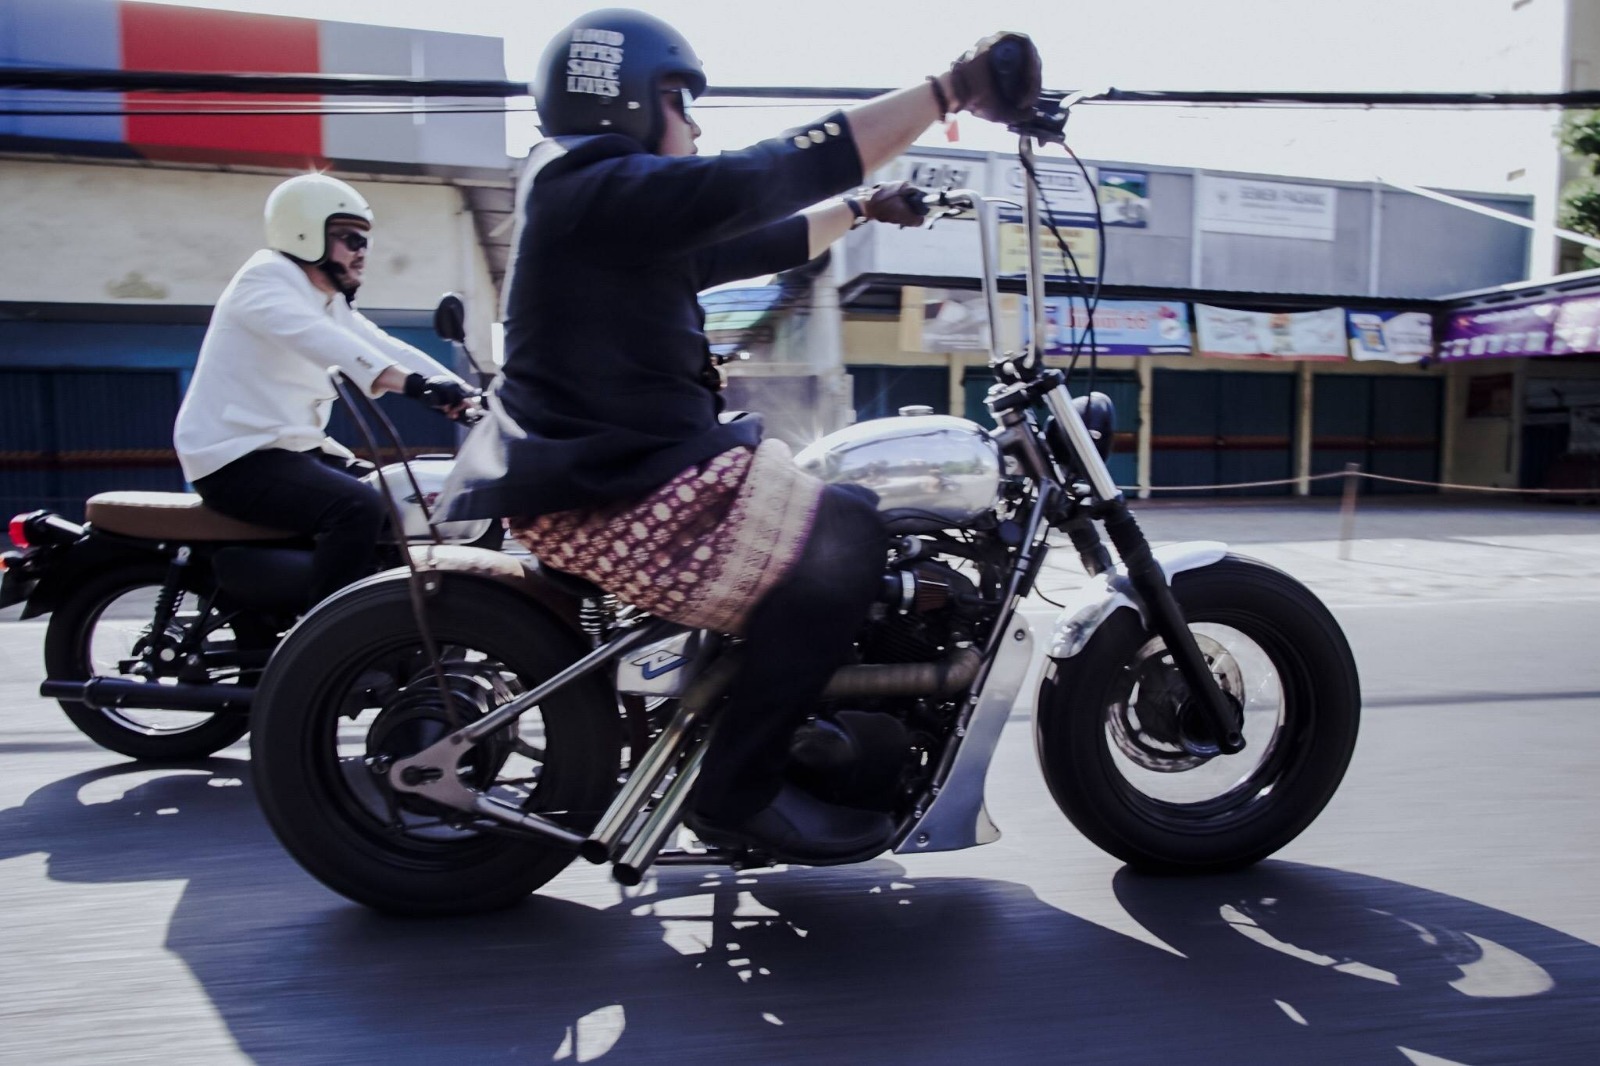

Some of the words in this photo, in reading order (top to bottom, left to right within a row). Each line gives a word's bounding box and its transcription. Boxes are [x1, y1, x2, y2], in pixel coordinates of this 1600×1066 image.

[572, 29, 625, 46] LOUD
[569, 43, 624, 64] PIPES
[567, 59, 620, 80] SAVE
[567, 76, 620, 97] LIVES
